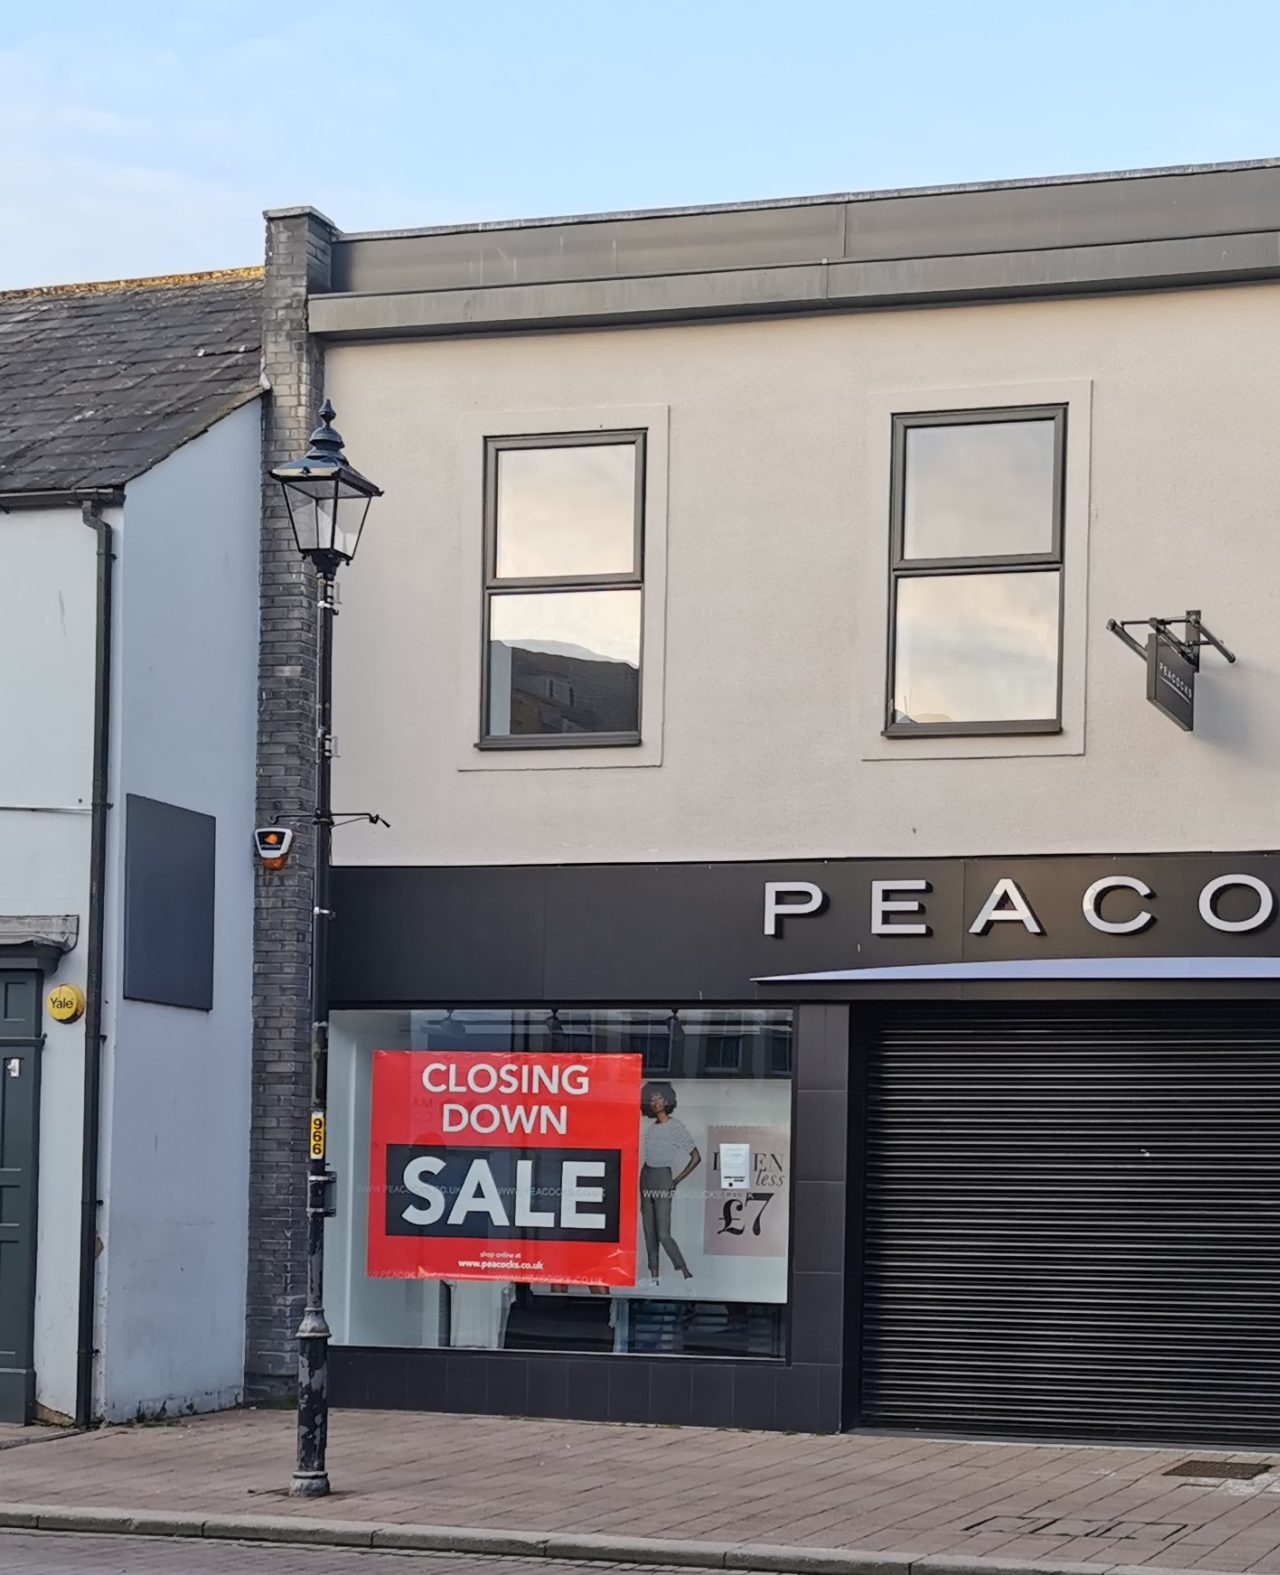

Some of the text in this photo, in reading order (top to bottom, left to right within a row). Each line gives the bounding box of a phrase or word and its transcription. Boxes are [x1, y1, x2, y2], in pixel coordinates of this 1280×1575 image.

[1159, 662, 1193, 699] PEACOCKS
[51, 997, 74, 1009] Yale
[421, 1062, 590, 1096] CLOSING
[313, 1118, 322, 1155] 966
[442, 1103, 568, 1136] DOWN
[401, 1155, 607, 1230] SALE
[754, 1168, 786, 1188] less
[717, 1191, 776, 1237] £7
[457, 1259, 544, 1270] www.peacocks.co.uk
